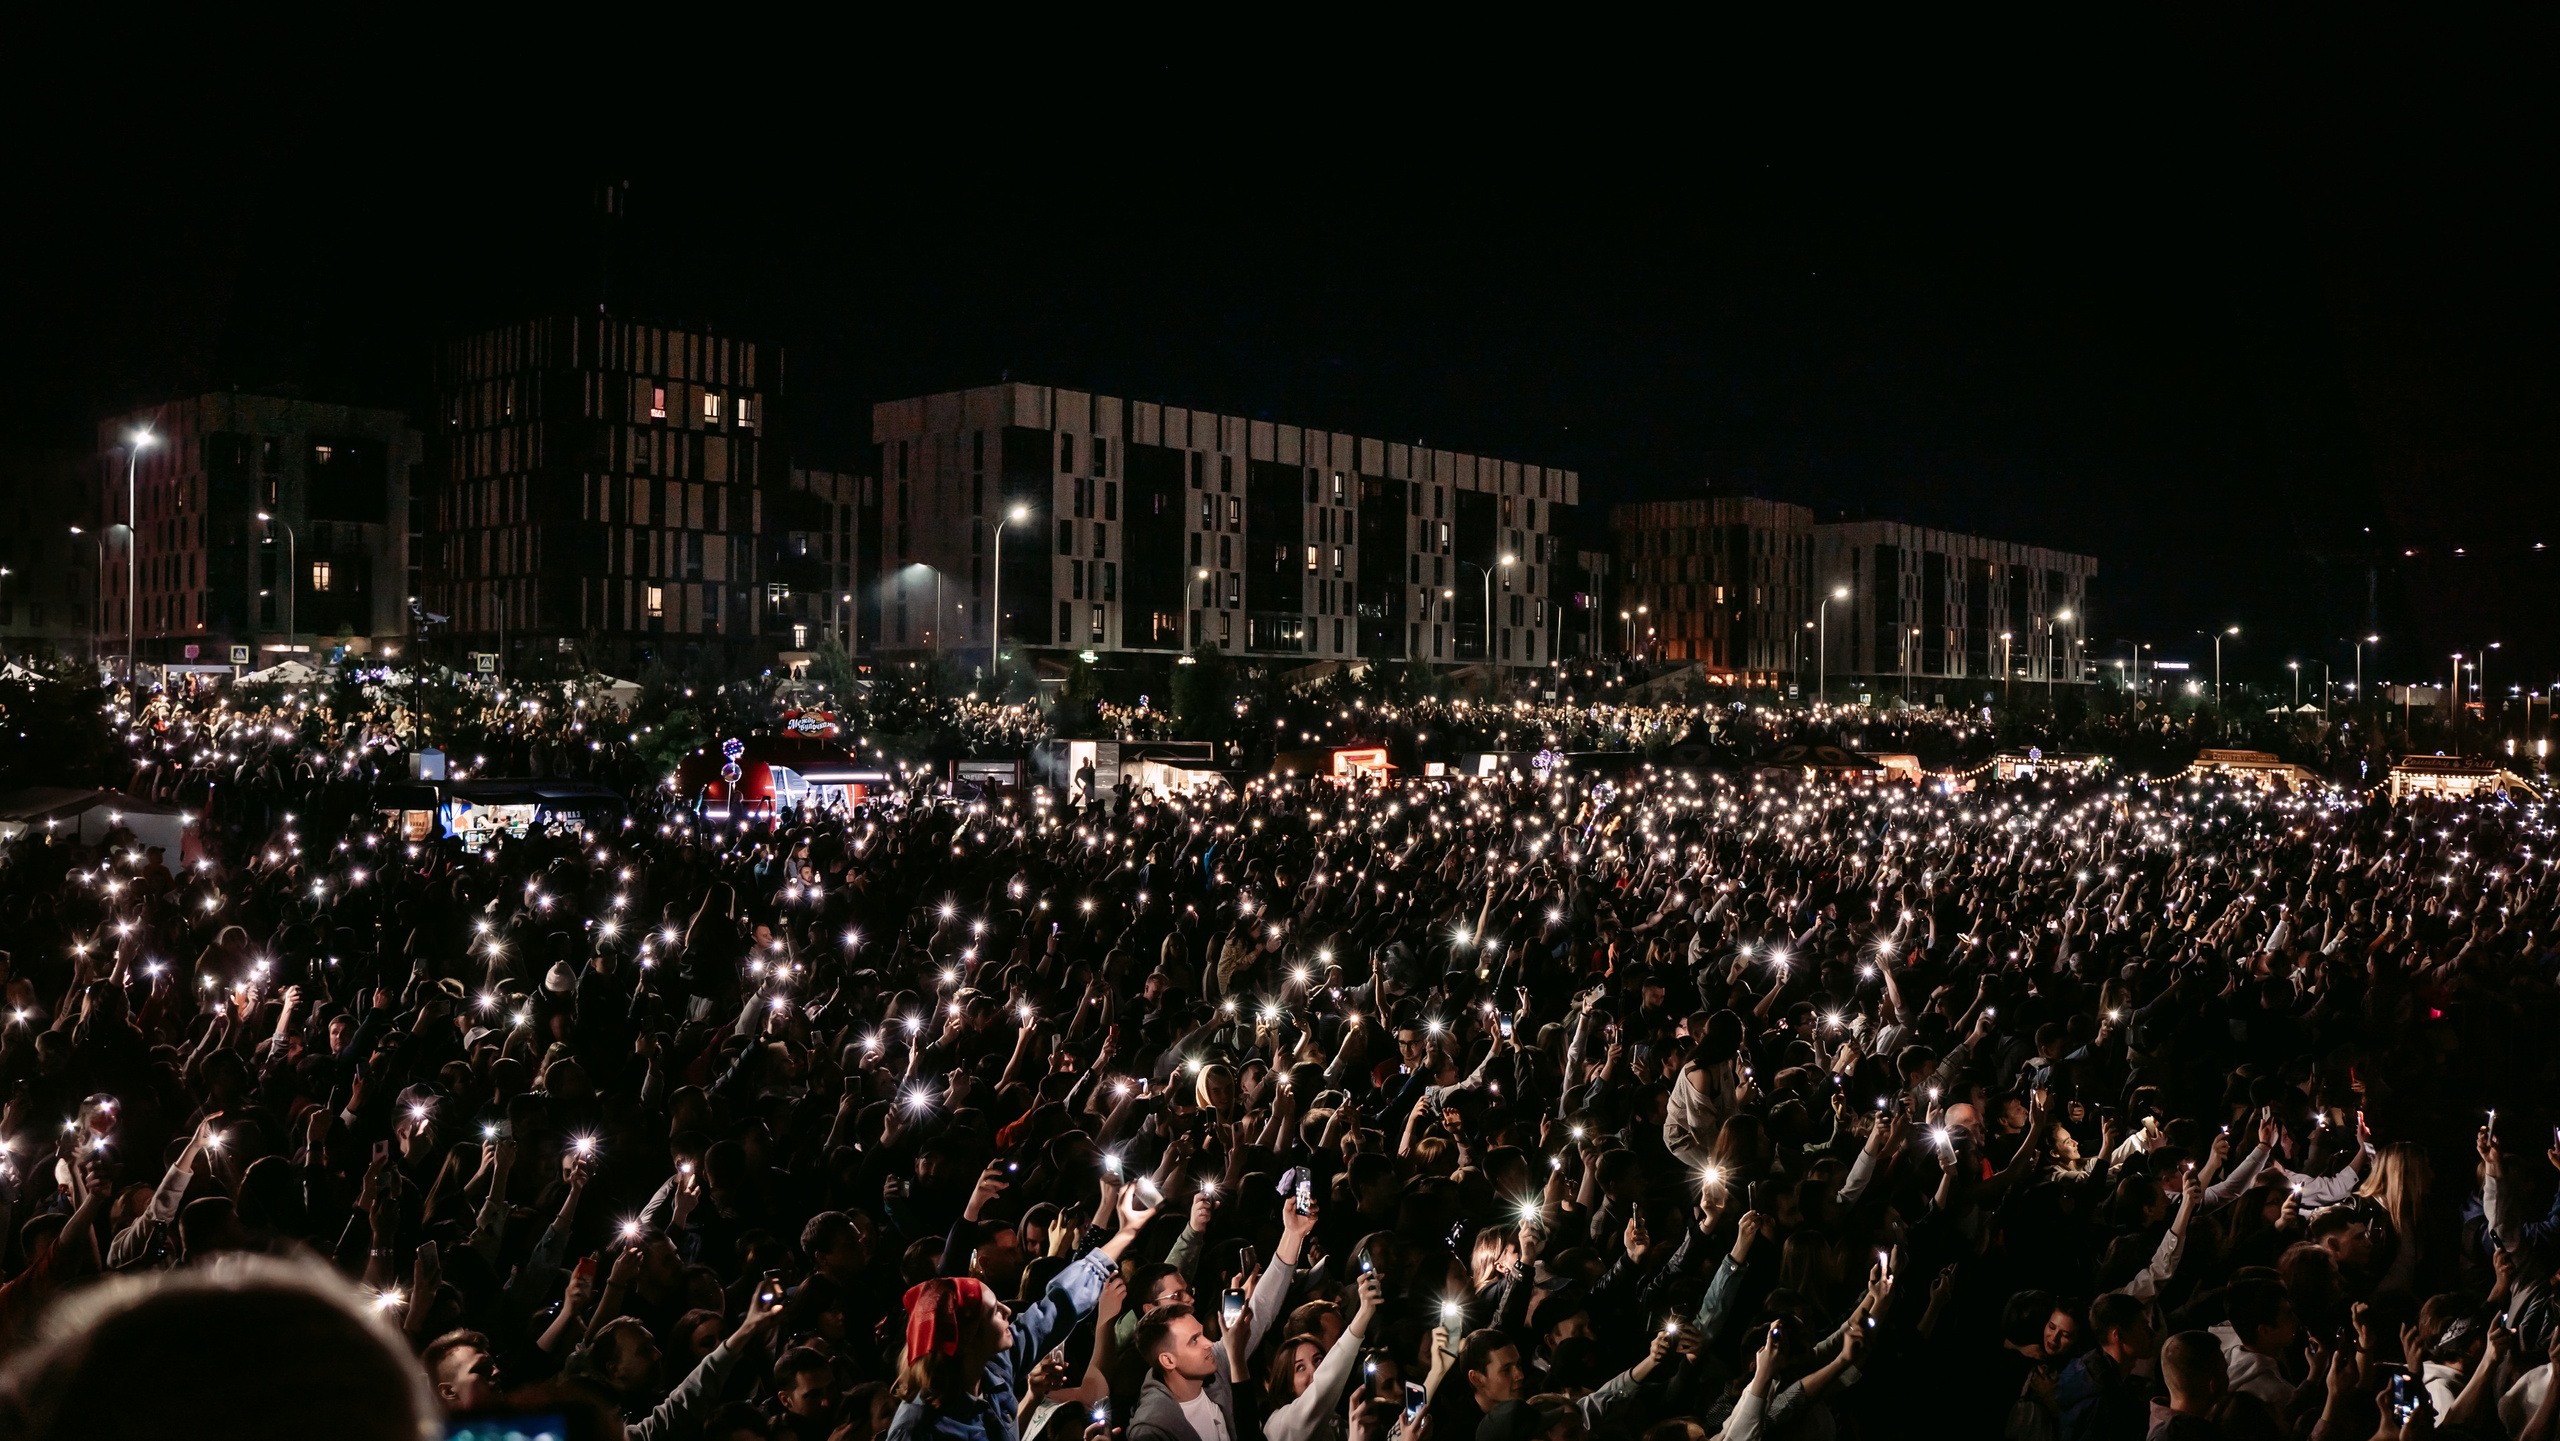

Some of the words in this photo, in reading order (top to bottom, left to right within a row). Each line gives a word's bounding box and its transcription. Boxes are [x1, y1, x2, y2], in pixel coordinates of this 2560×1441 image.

[787, 717, 816, 730] Между
[2212, 752, 2247, 761] COUNTRY
[2401, 757, 2450, 767] Country
[2463, 759, 2495, 768] Grill
